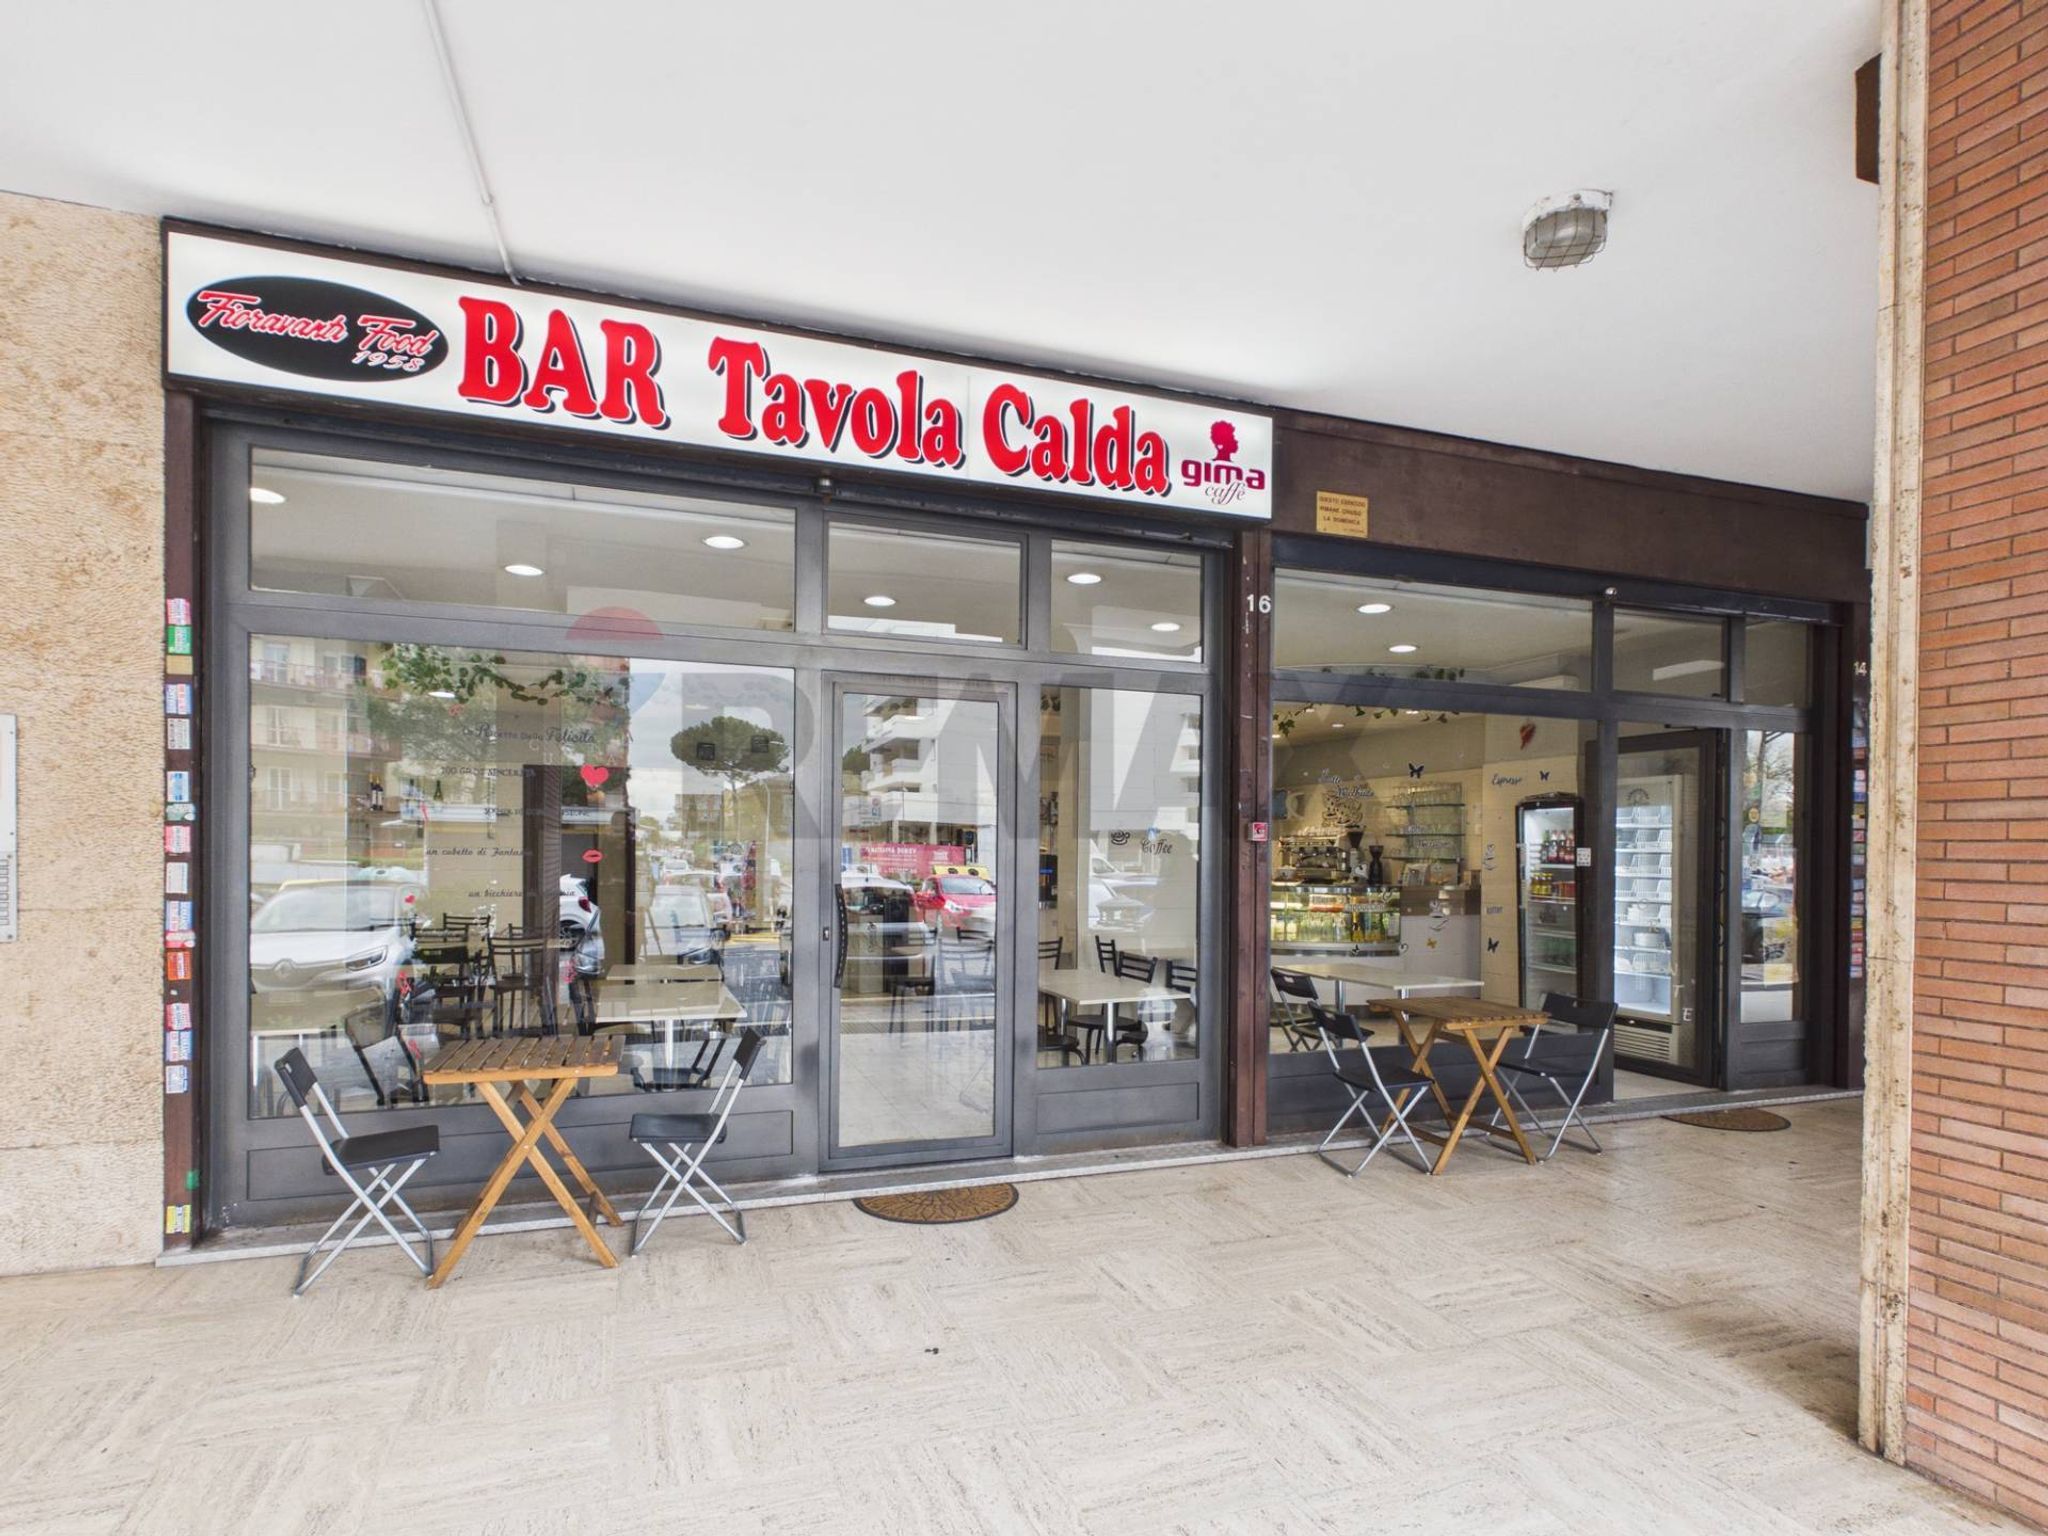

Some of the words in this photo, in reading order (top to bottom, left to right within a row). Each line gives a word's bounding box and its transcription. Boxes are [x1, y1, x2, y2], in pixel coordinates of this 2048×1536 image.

[357, 314, 438, 356] Food
[351, 350, 425, 372] 1958
[457, 295, 671, 431] BAR
[707, 335, 966, 470] Tavola
[981, 383, 1173, 498] Calda
[1181, 459, 1265, 490] gima
[1246, 593, 1272, 614] 16
[1853, 661, 1867, 676] 14
[1140, 839, 1174, 856] Coffee
